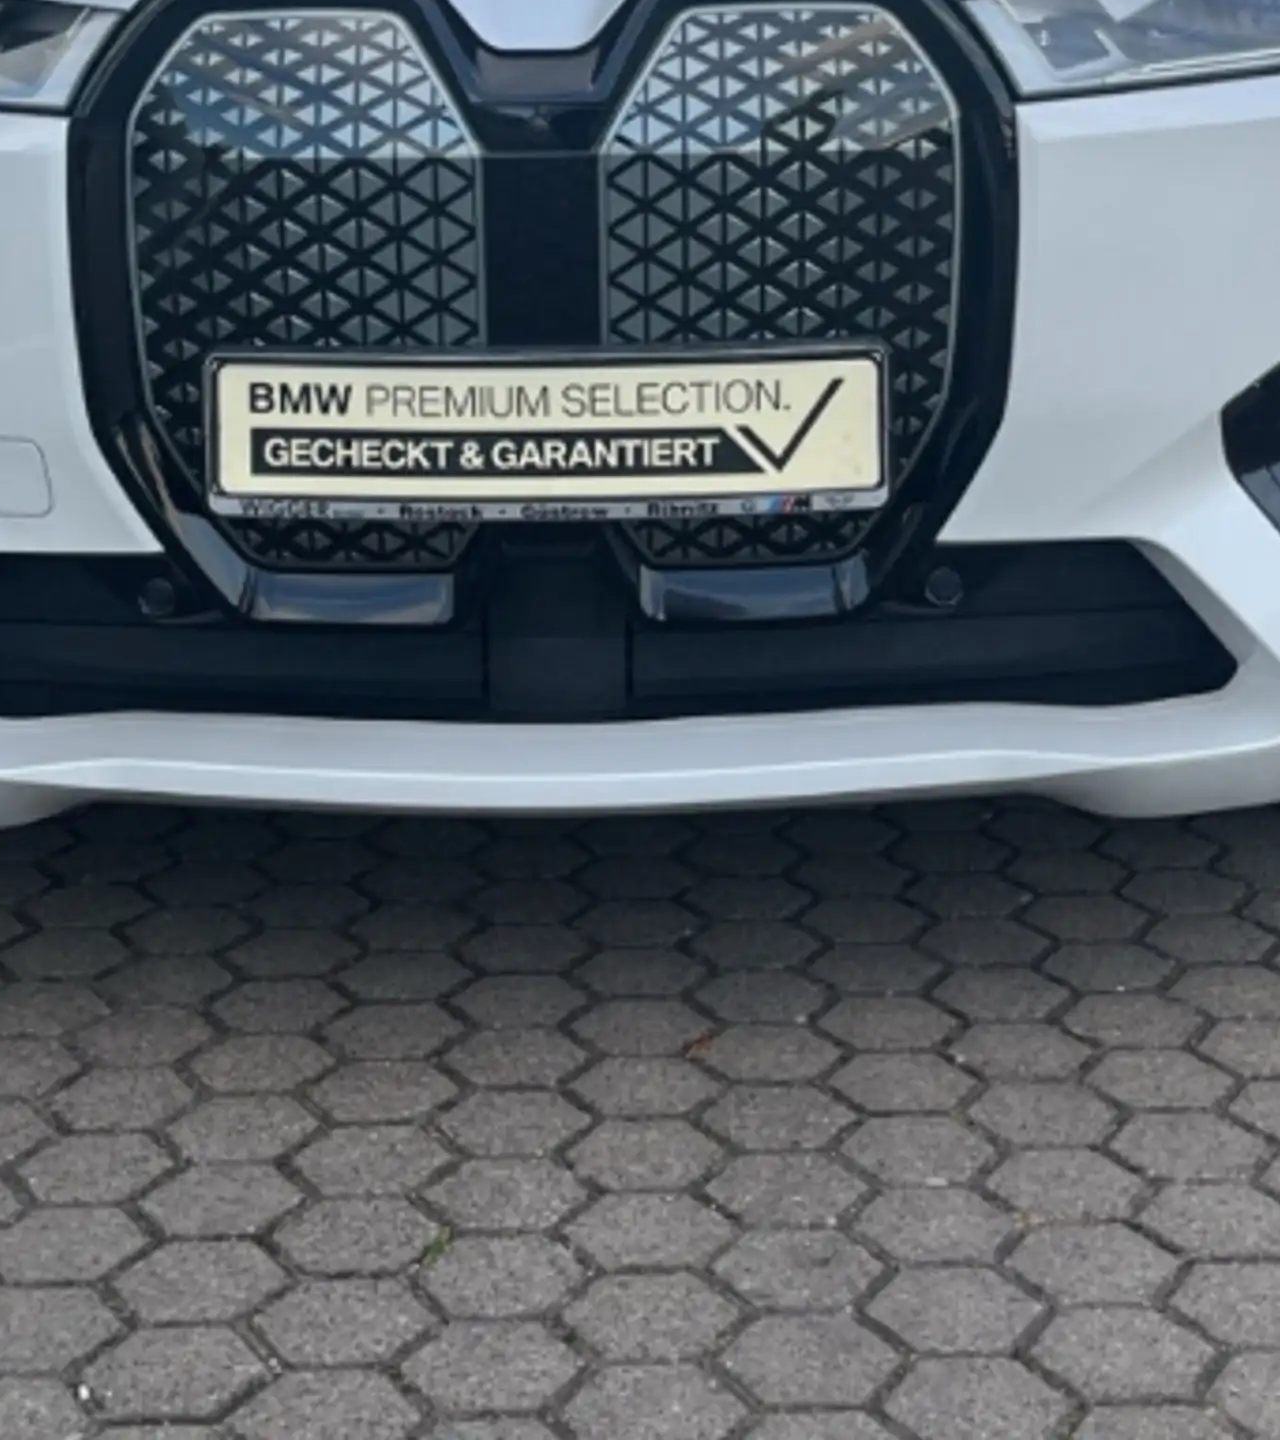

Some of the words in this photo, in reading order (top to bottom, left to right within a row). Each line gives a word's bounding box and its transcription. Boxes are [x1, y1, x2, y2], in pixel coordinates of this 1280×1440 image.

[248, 381, 353, 415] BMW
[365, 384, 552, 419] PREMIUM
[560, 378, 791, 418] SELECTION.
[263, 437, 454, 470] GECHECKT
[458, 440, 485, 470] &
[489, 436, 720, 471] GARANTIERT
